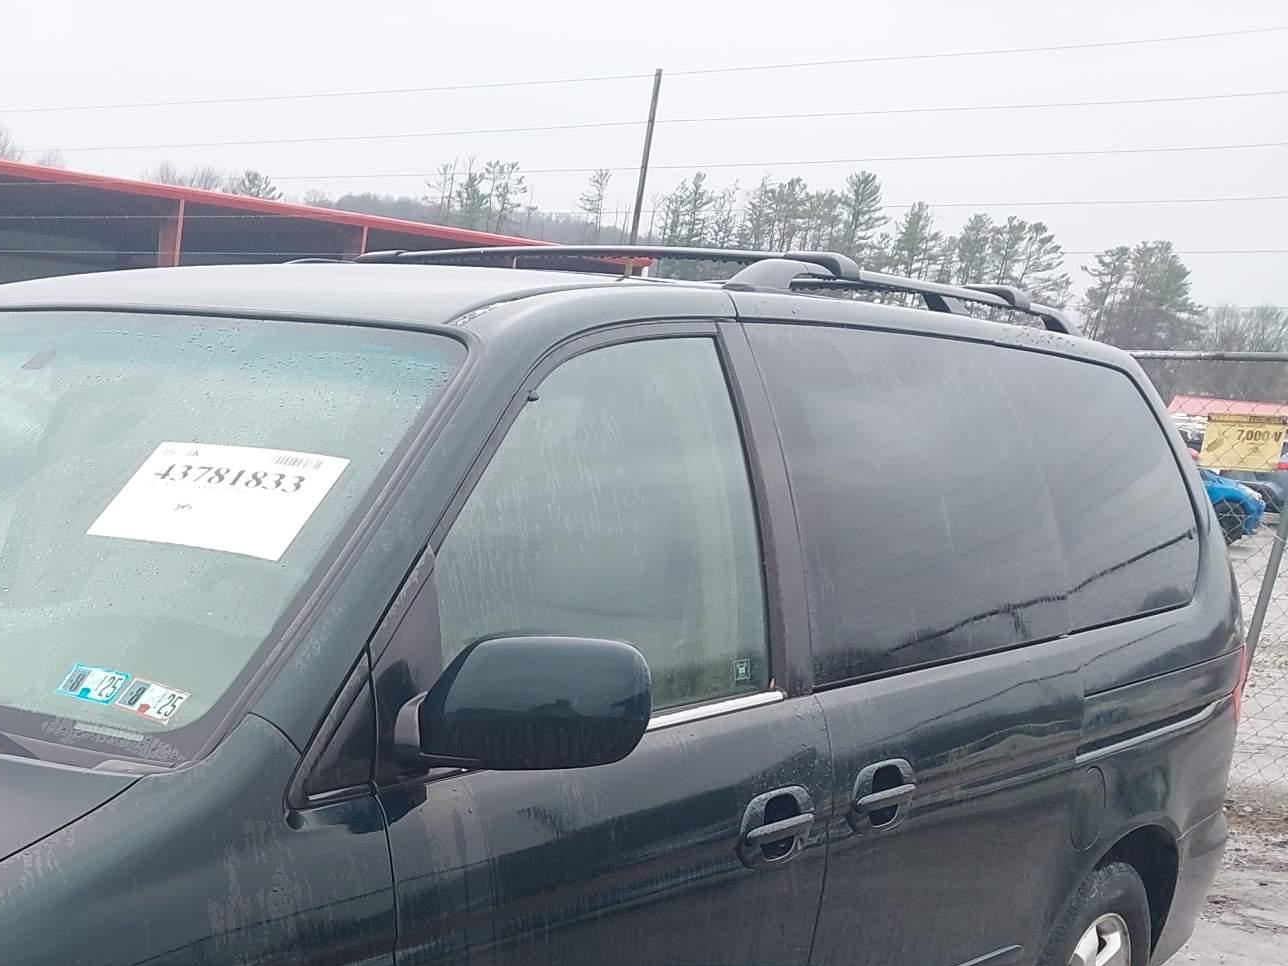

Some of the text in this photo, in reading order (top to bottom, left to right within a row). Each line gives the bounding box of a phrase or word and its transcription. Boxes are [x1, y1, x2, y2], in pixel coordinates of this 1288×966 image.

[1237, 429, 1271, 442] 7,000
[154, 463, 306, 494] 43781833
[97, 676, 124, 698] 25
[156, 693, 184, 717] 25
